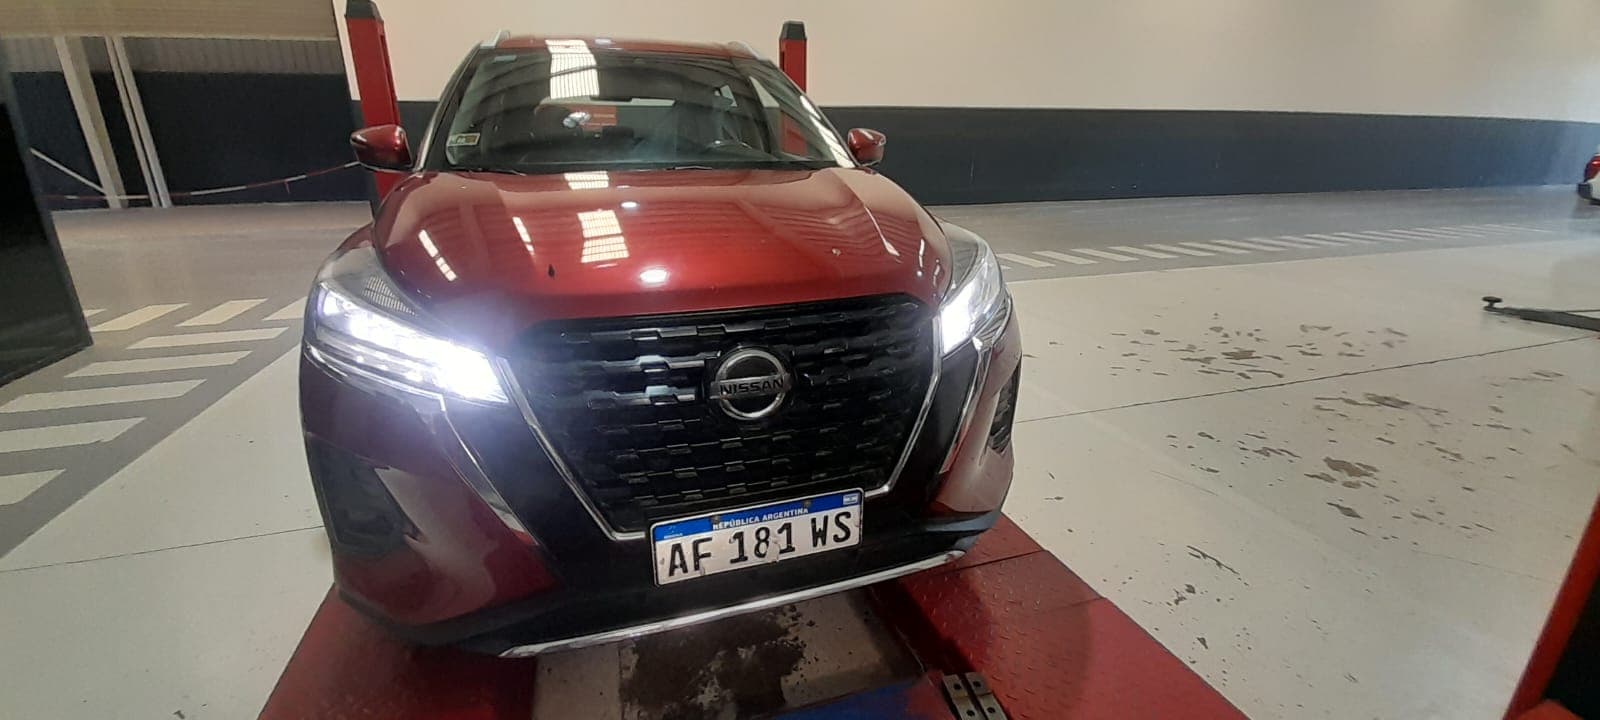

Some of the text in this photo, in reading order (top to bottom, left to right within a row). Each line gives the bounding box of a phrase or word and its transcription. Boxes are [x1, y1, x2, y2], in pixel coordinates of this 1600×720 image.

[719, 378, 784, 395] NISSAN
[713, 508, 809, 530] REPÚBLICA ARGENTINA
[668, 511, 852, 577] AF 181 WS
